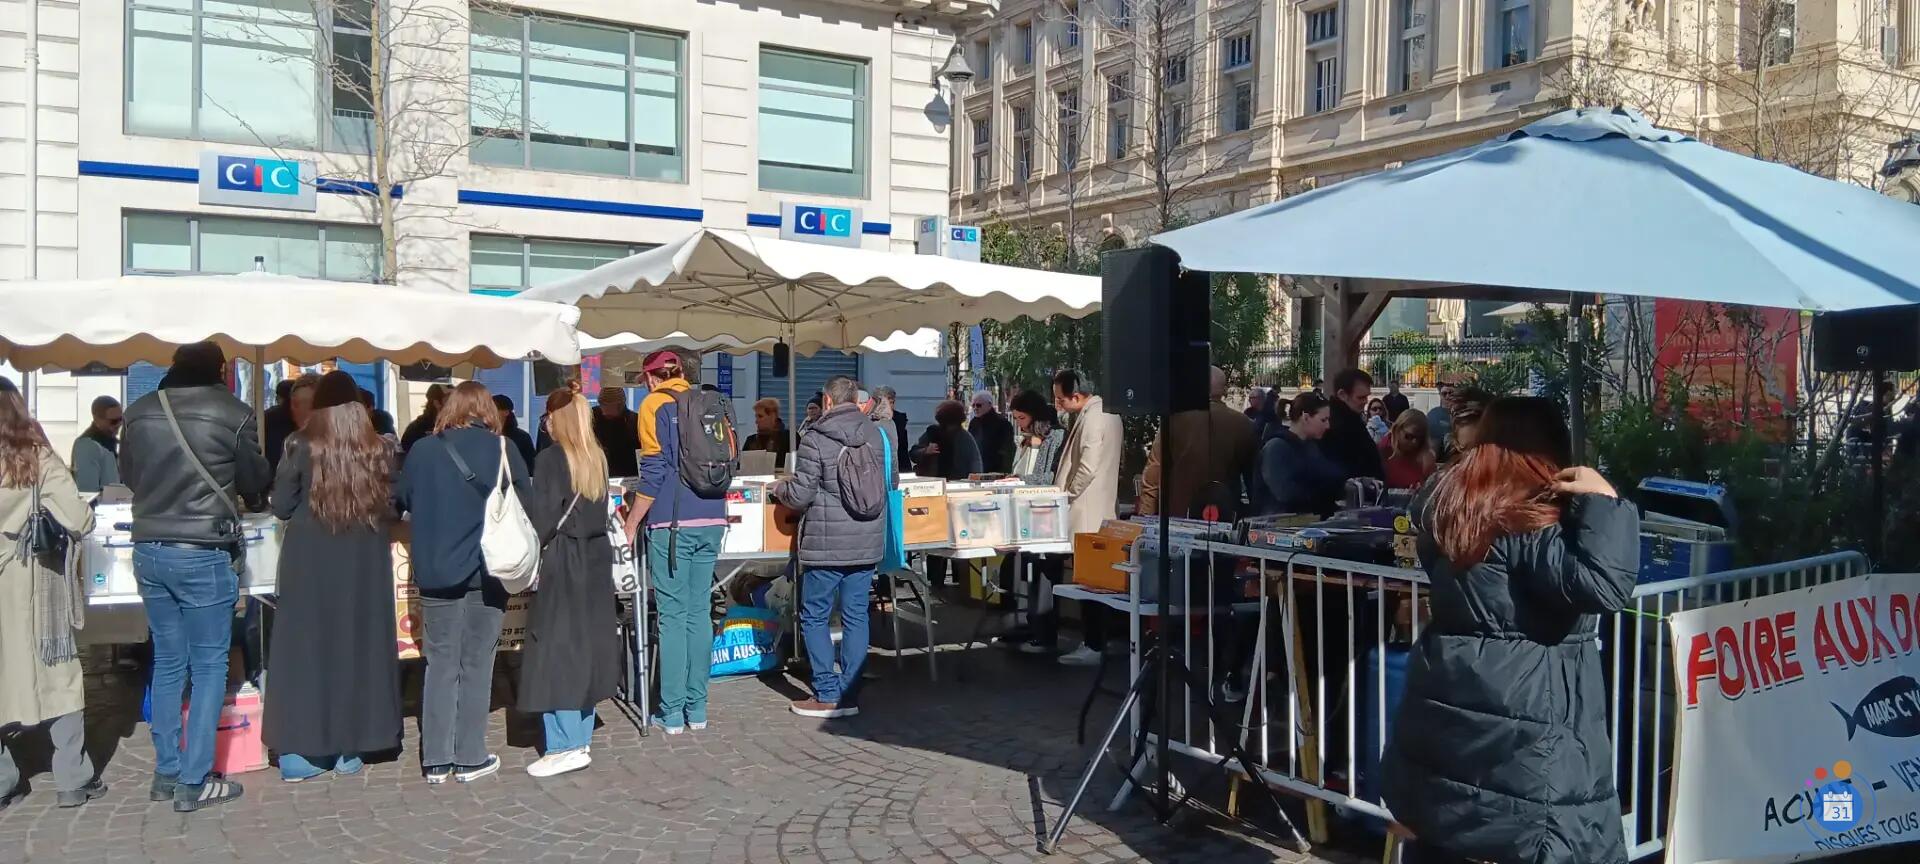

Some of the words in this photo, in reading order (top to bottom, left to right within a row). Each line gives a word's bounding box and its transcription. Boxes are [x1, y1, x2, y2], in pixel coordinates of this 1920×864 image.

[226, 163, 291, 188] CIC
[800, 211, 846, 232] CIC
[953, 229, 975, 240] CIC
[1686, 611, 1804, 708] FOIRE
[1814, 595, 1898, 675] AUX
[1862, 697, 1898, 728] MARS
[1764, 777, 1853, 832] ACH
[1878, 811, 1919, 838] TOUS
